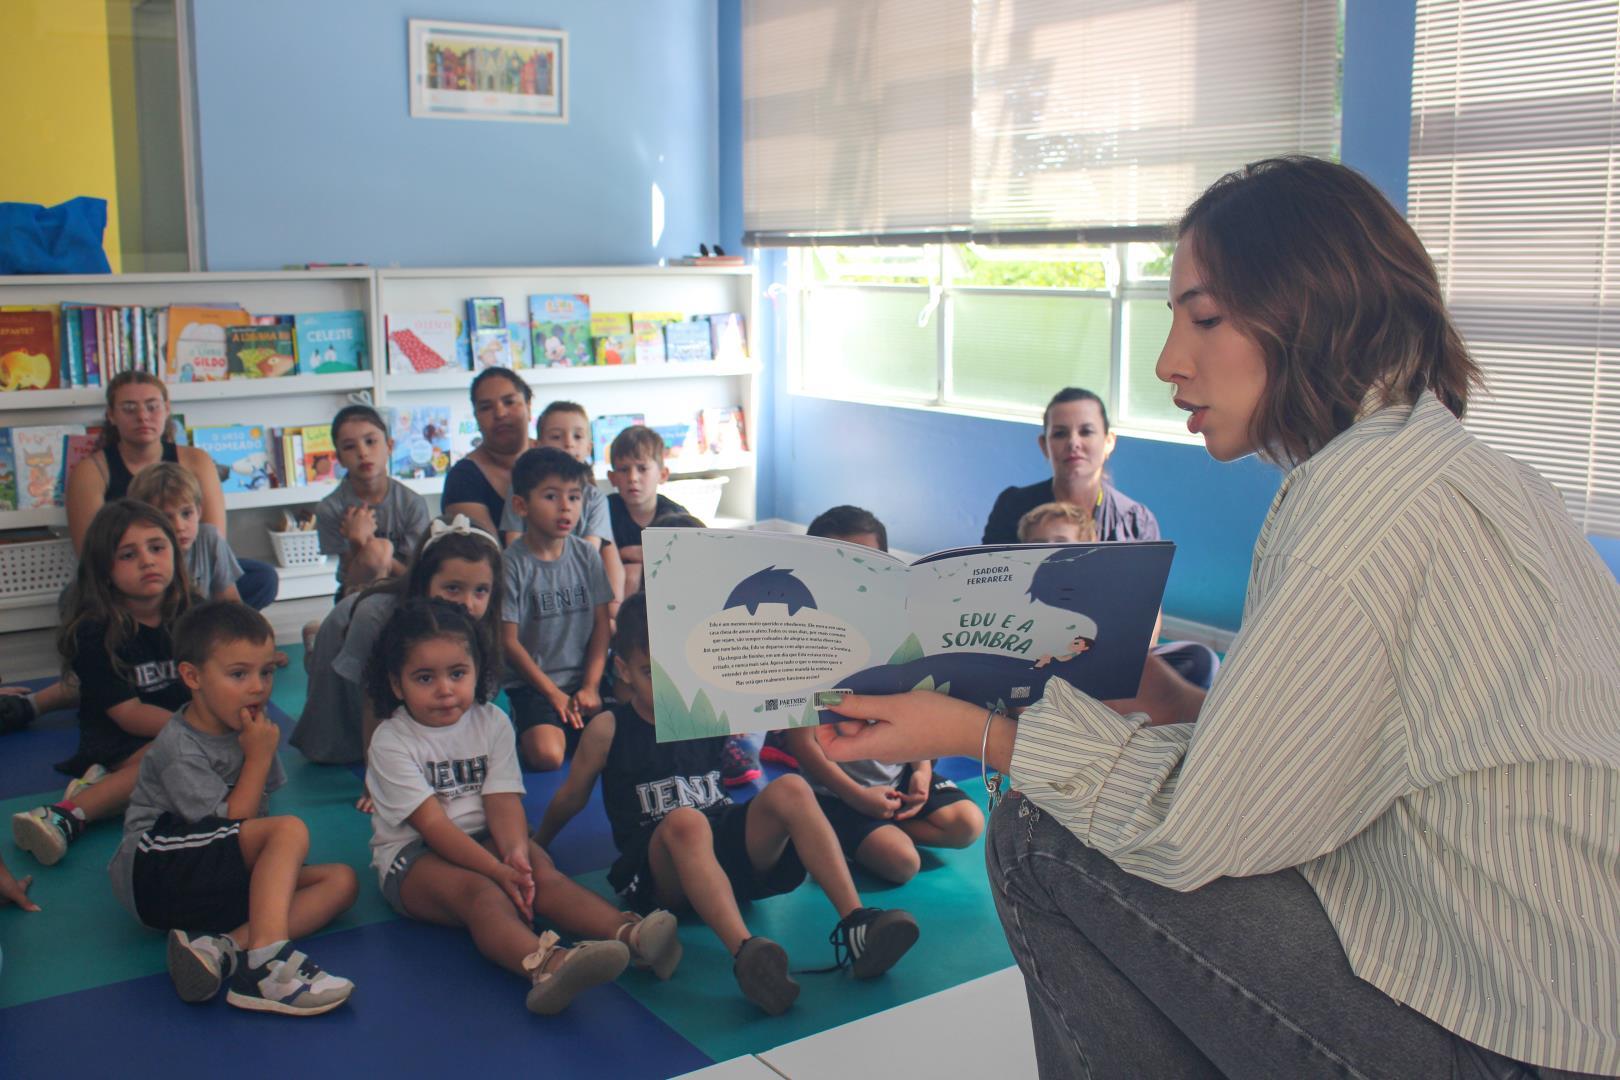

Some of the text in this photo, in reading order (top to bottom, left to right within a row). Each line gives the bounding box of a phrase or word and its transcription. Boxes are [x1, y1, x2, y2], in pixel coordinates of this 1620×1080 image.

[306, 327, 354, 344] CELESTE
[193, 356, 226, 369] GILDO
[972, 566, 1010, 576] ISADORA
[966, 574, 1014, 585] FERRAREZE
[959, 612, 1034, 633] EDU E A
[941, 630, 1034, 654] SOMBRA
